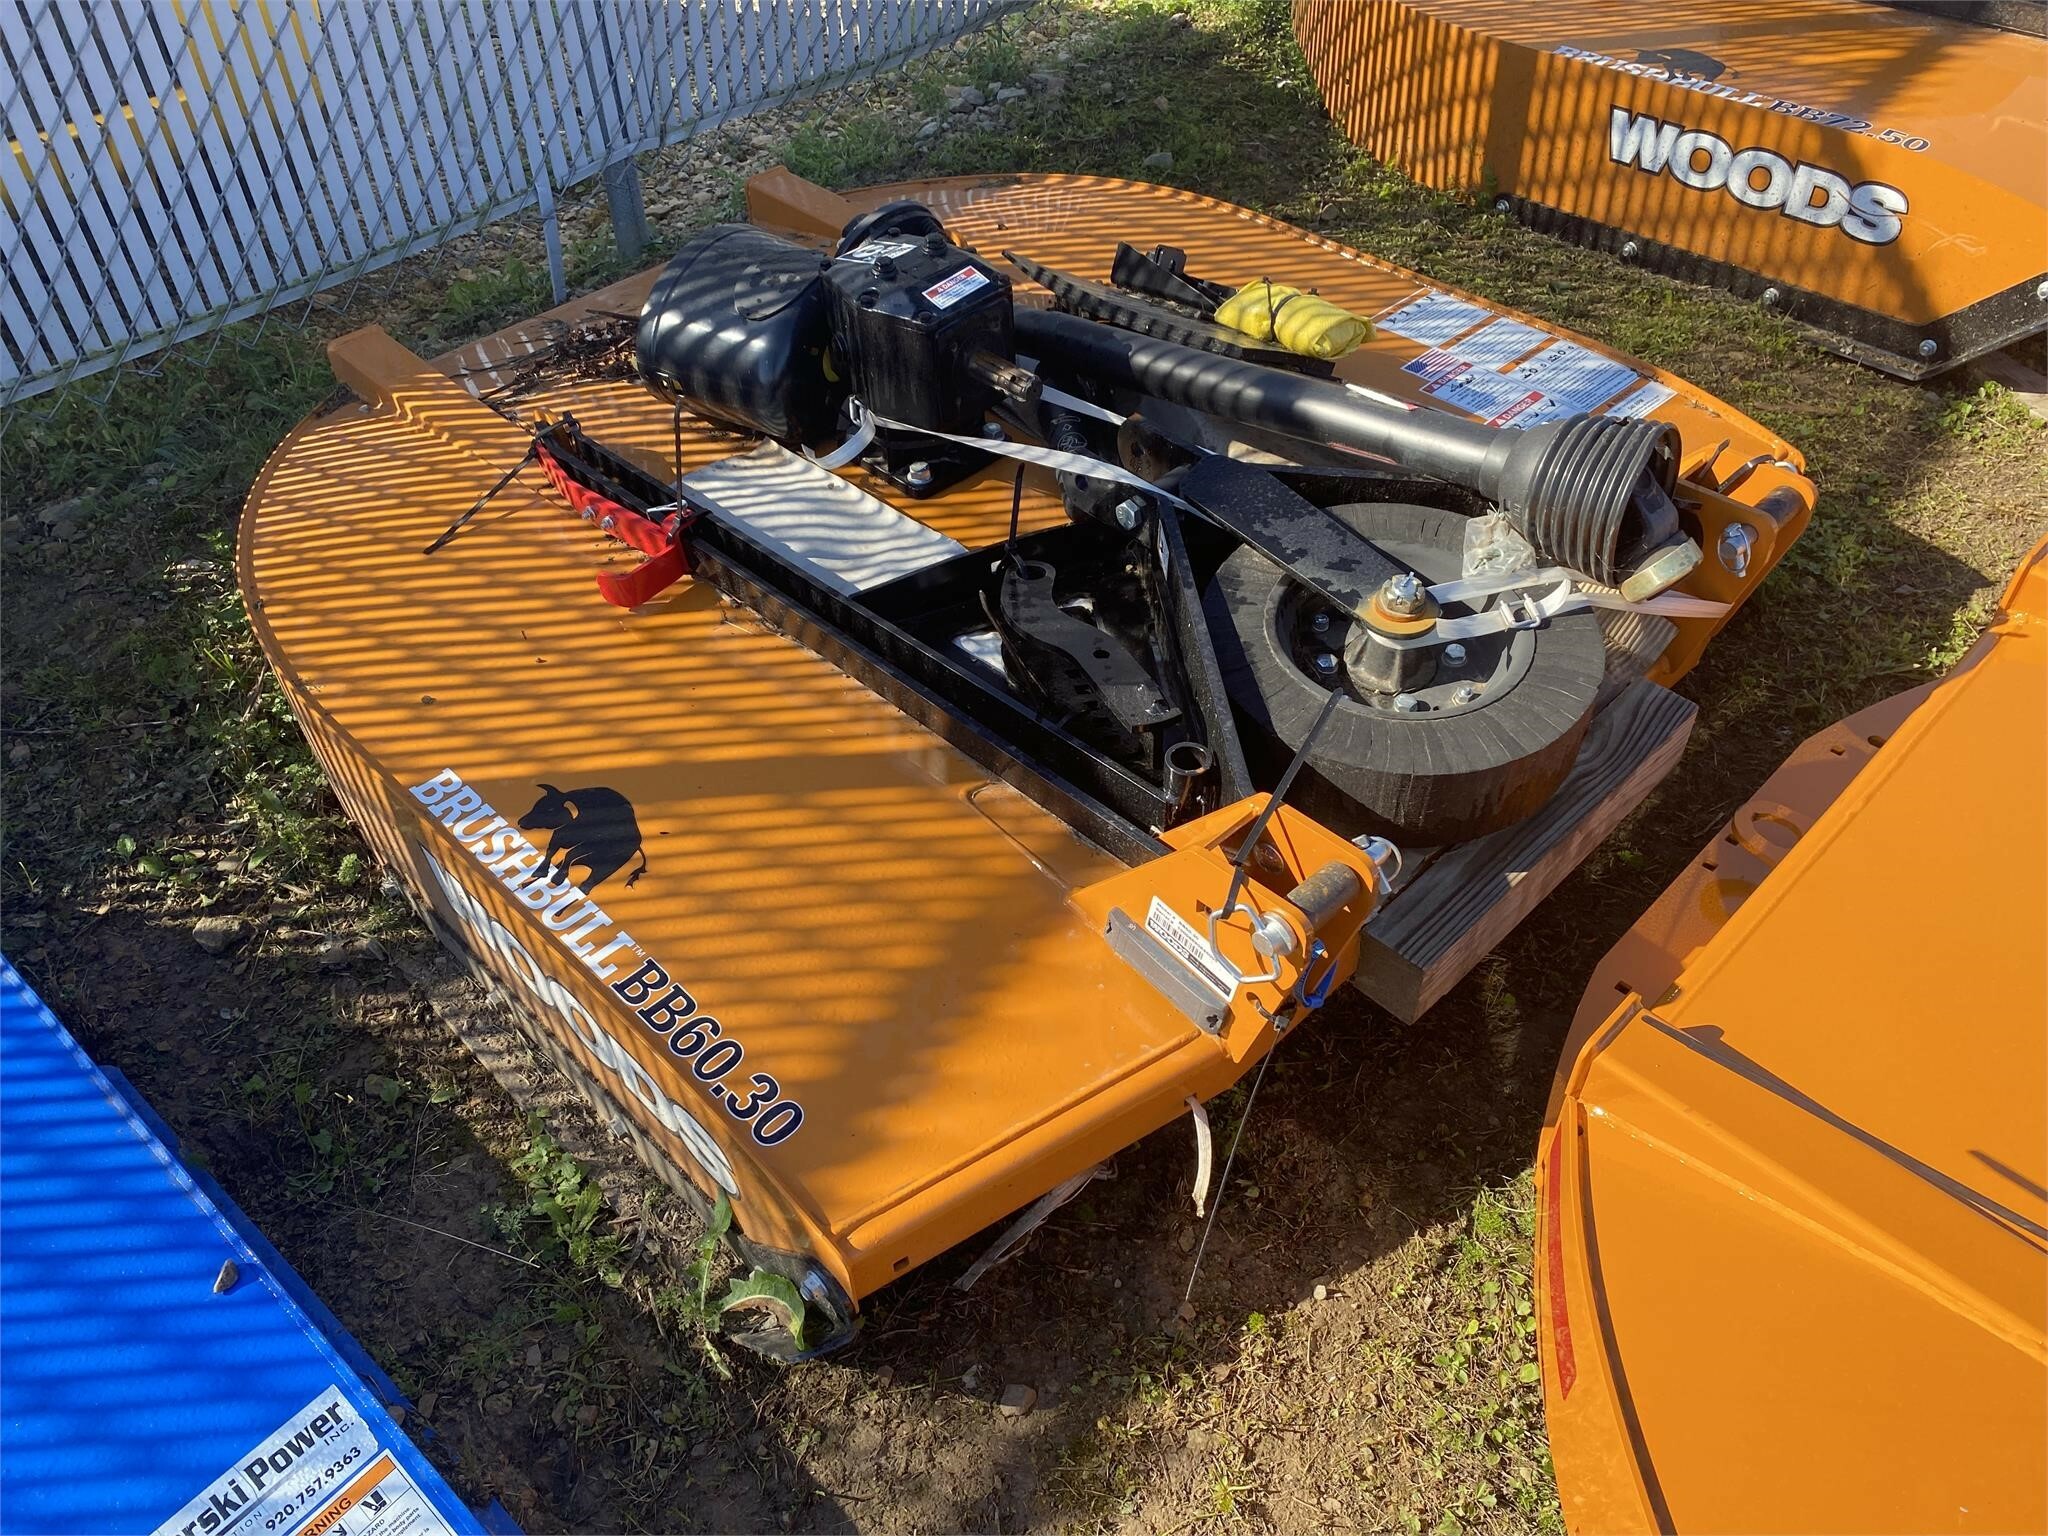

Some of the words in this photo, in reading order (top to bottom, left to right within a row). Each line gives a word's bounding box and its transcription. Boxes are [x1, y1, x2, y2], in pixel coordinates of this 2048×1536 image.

[1766, 98, 1931, 153] BB72.50
[1609, 104, 1909, 247] WOODS
[1439, 362, 1469, 385] DANGER
[1502, 397, 1535, 420] DANGER
[410, 767, 637, 981] BRUSHBULL
[611, 957, 805, 1147] BB60.30
[419, 842, 742, 1199] WOODS
[244, 1400, 342, 1491] Power
[324, 1421, 355, 1446] INC.
[265, 1446, 362, 1533] 920.757.9363
